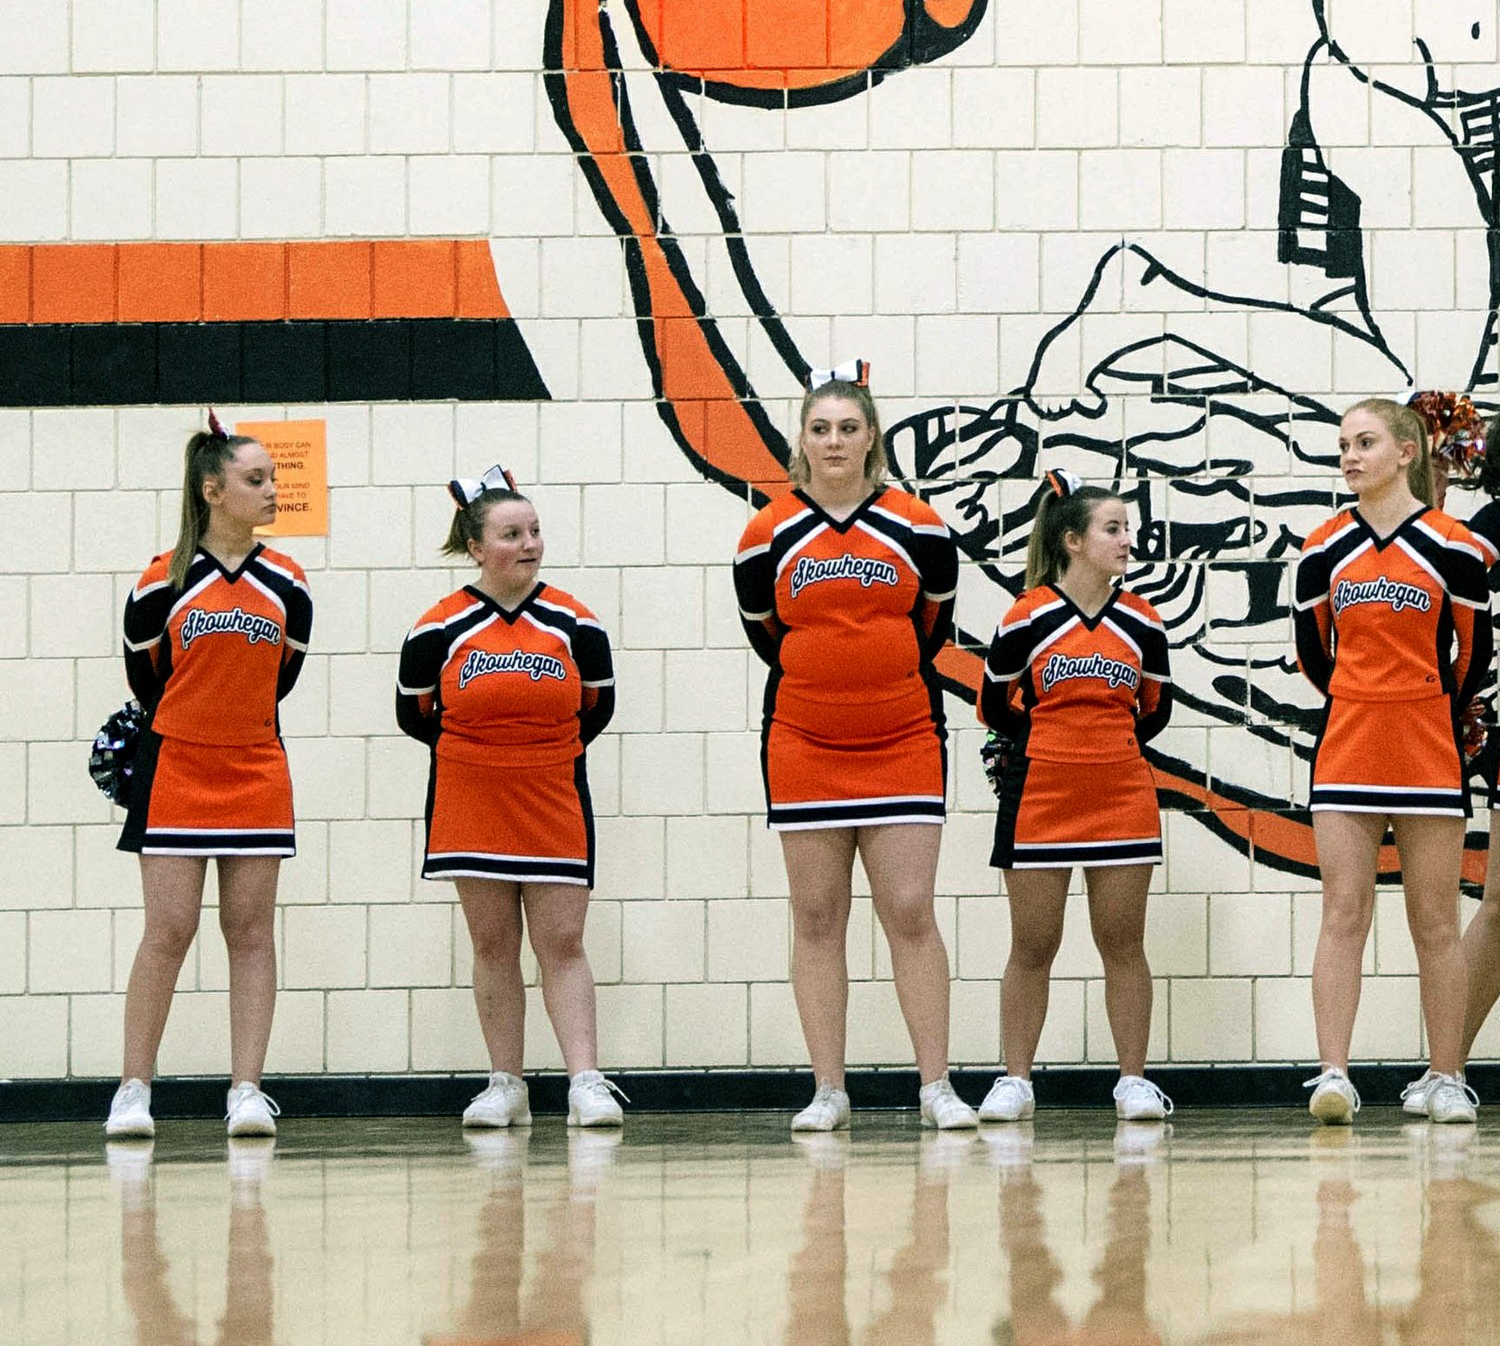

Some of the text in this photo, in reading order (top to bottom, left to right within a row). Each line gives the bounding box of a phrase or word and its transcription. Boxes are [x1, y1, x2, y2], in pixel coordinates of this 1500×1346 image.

[274, 461, 305, 470] THING
[277, 502, 312, 512] VINCE.
[790, 555, 899, 599] Skowhegan
[1333, 576, 1431, 620] Skowhegan
[180, 608, 282, 650] Skowhegan
[459, 649, 567, 690] Skowhegan
[1042, 653, 1138, 692] Skowhegan
